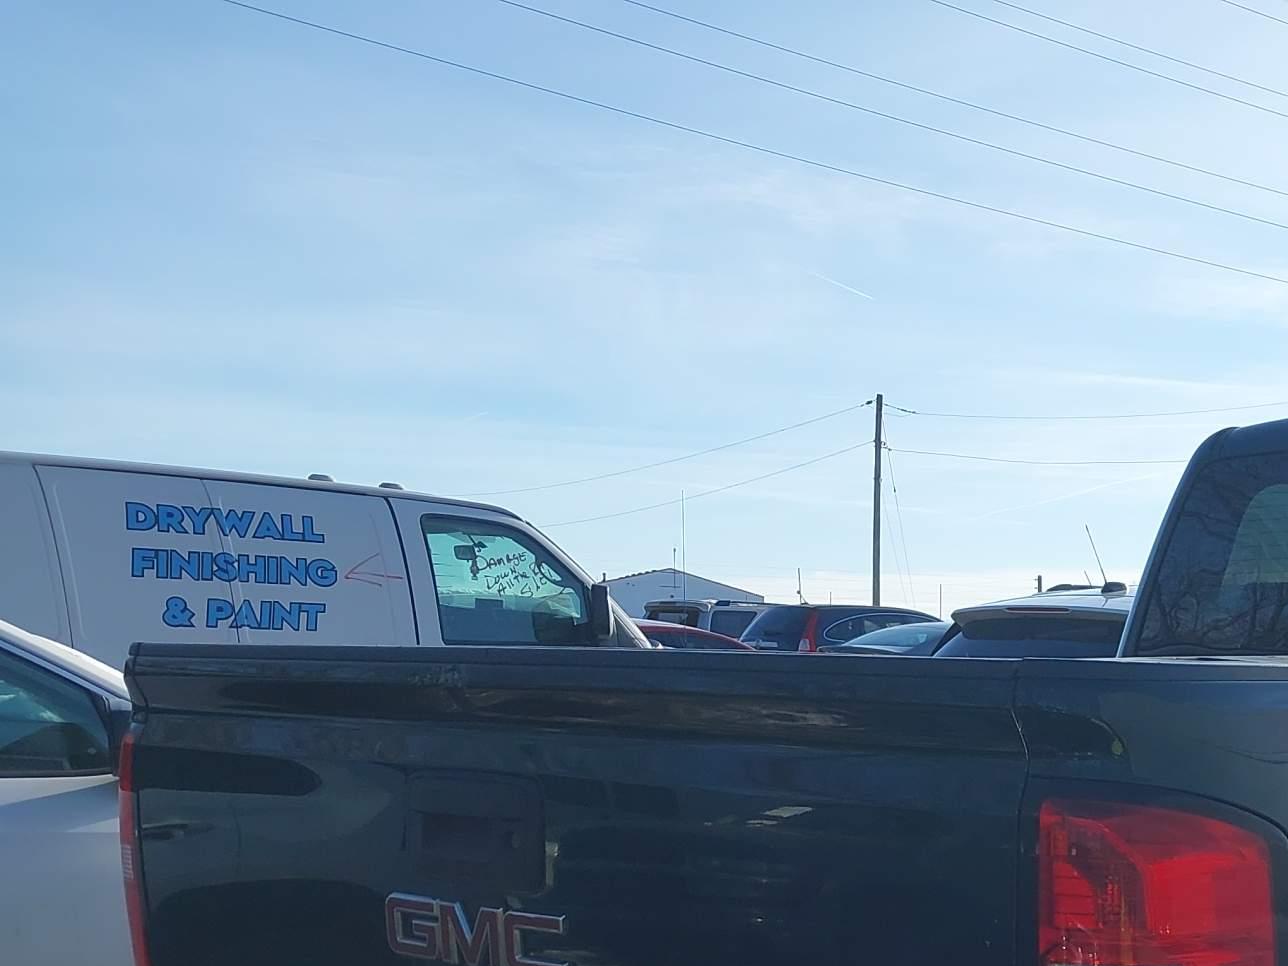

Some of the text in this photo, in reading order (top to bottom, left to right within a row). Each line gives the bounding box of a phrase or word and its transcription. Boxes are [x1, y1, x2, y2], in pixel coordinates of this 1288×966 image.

[125, 501, 325, 543] DRYWALL
[131, 547, 338, 587] FINISHING
[162, 596, 326, 631] & PAINT
